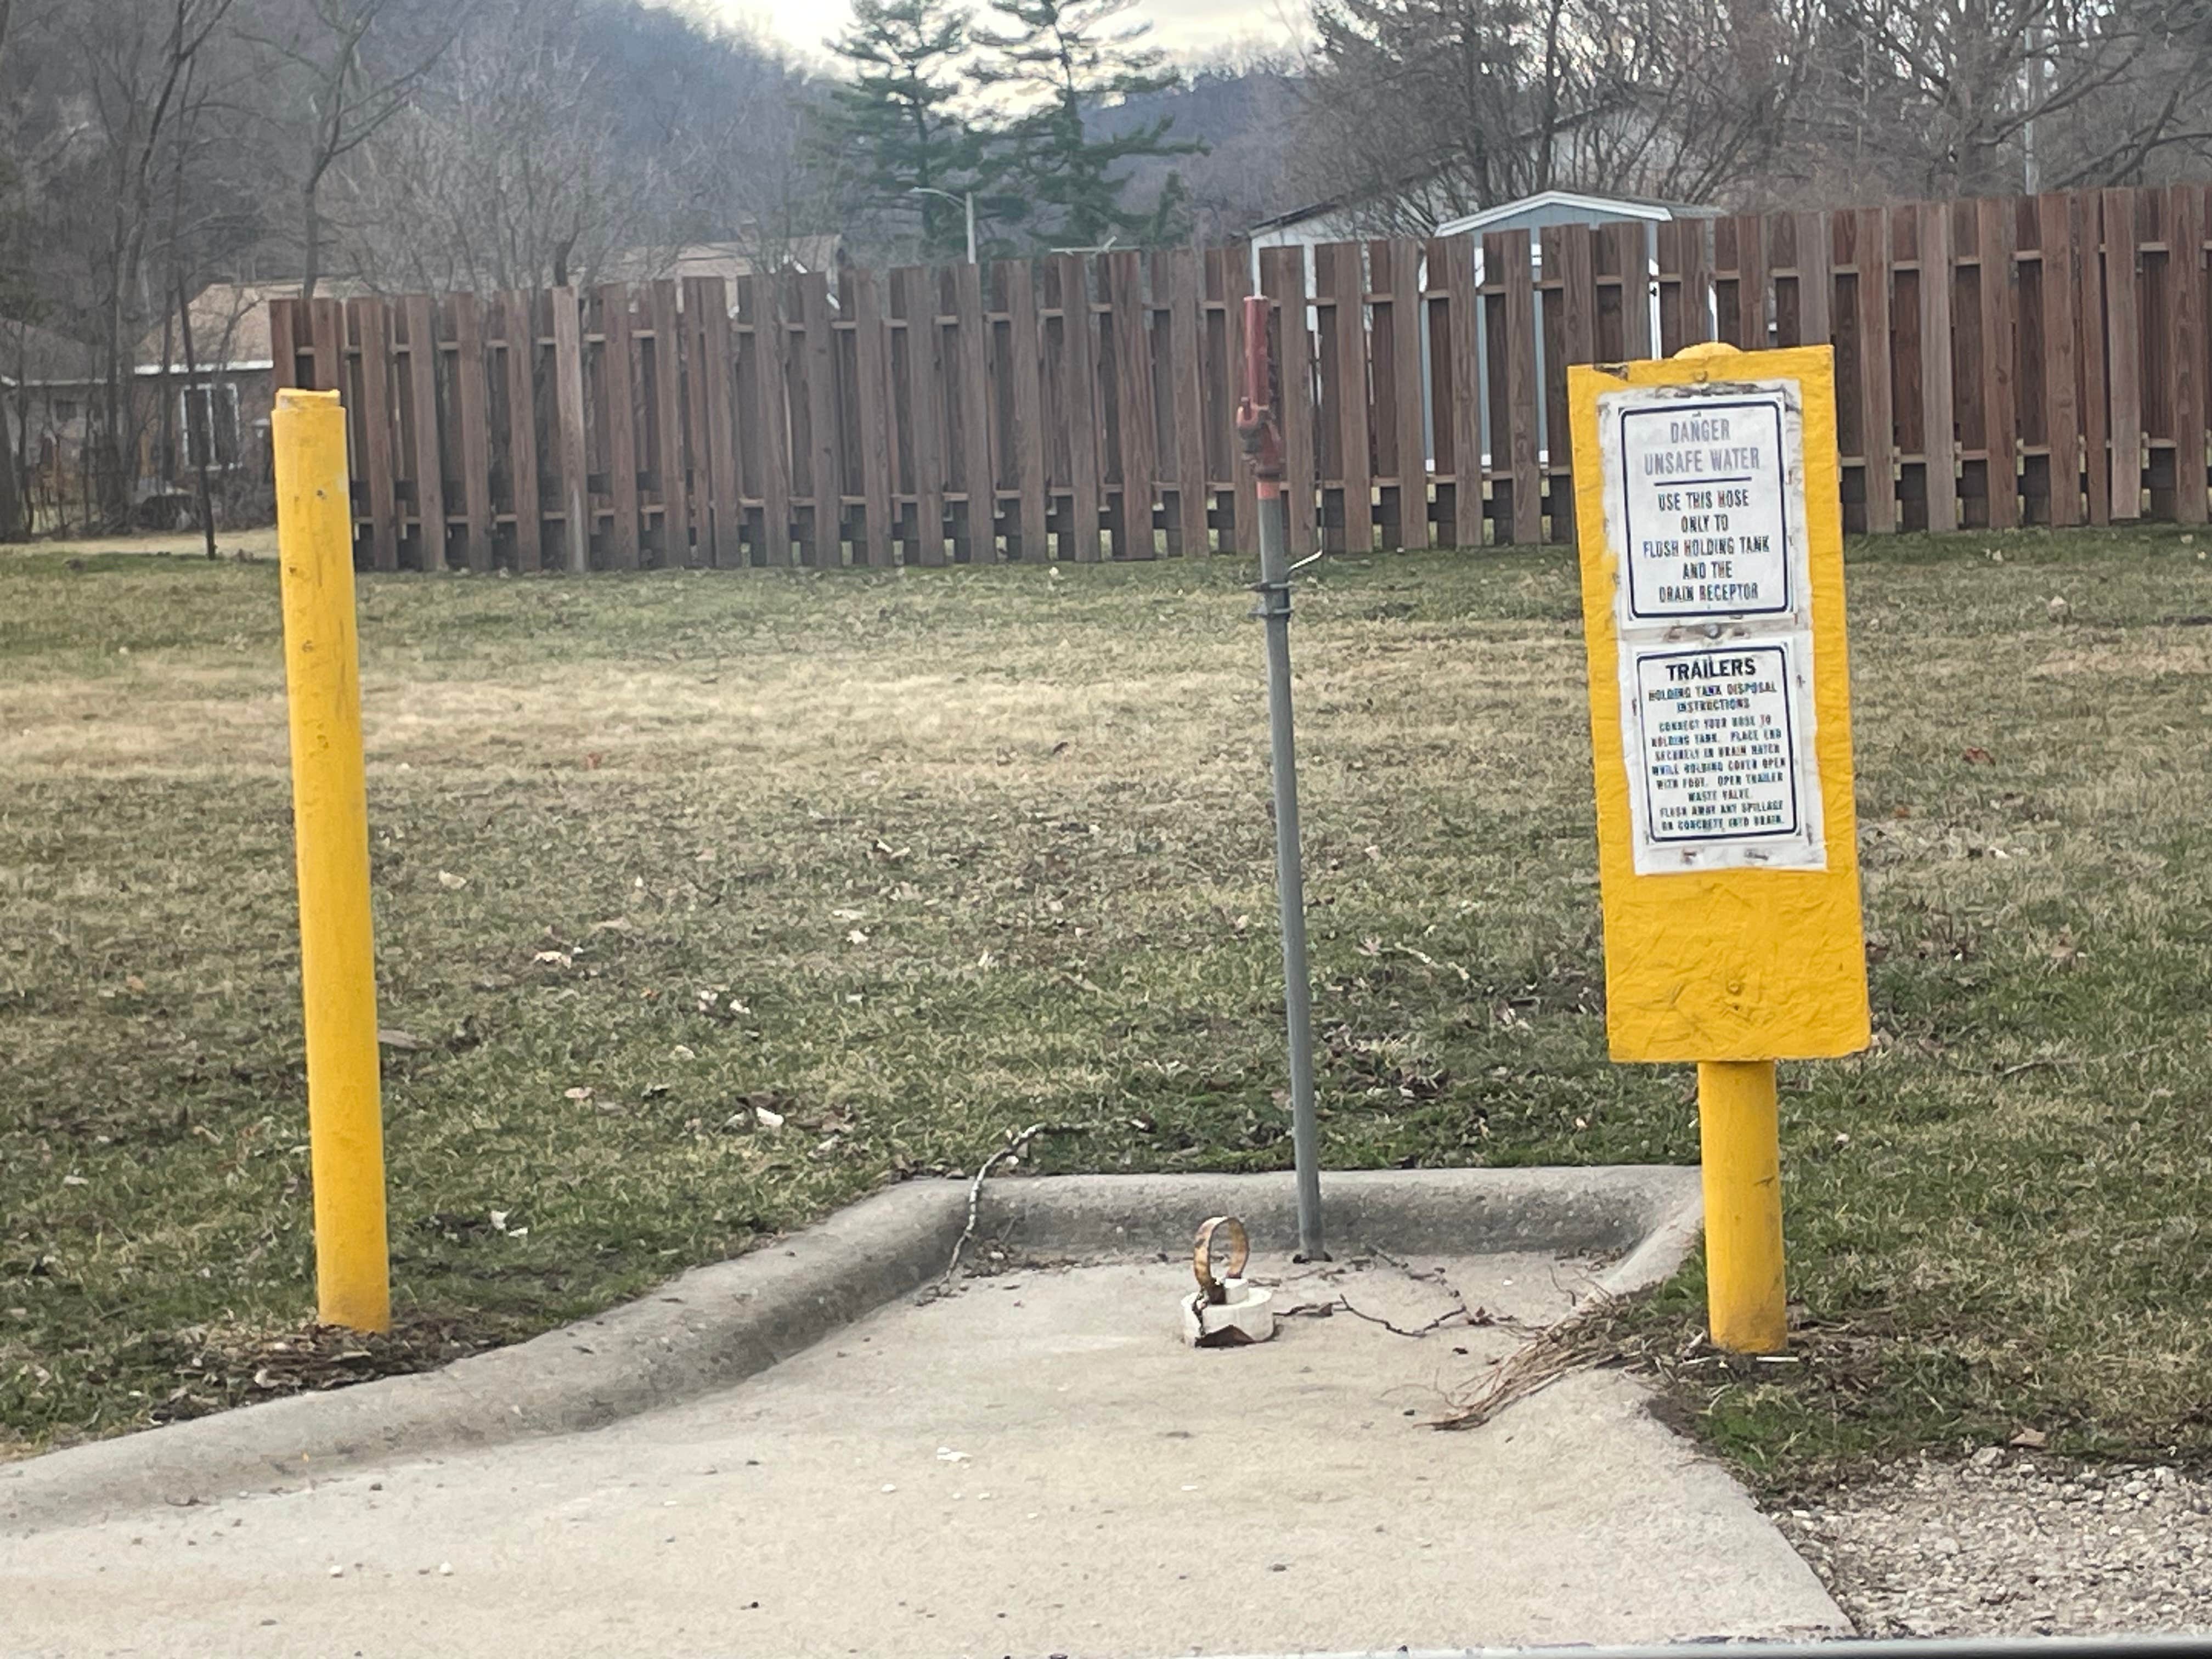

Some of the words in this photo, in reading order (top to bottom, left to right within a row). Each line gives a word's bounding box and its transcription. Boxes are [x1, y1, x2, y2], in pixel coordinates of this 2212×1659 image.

[1671, 419, 1730, 443] DANGER
[1645, 450, 1703, 476] UNSAFE
[1711, 447, 1759, 471] WATER
[1658, 493, 1681, 511] USE
[1686, 492, 1712, 509] THIS
[1718, 489, 1750, 507] HOSE
[1681, 515, 1709, 533] ONLY
[1714, 514, 1729, 531] TO
[1643, 540, 1679, 558] FLUSH
[1684, 538, 1734, 557] HOLDING
[1740, 535, 1770, 552] TANK
[1683, 562, 1706, 580] AND
[1711, 561, 1733, 578] THE
[1660, 585, 1694, 604] DRAIN
[1699, 583, 1758, 601] RECEPTOR
[1666, 658, 1756, 681] TRAILERS
[1649, 686, 1691, 701] HOLDING
[1695, 685, 1722, 697] TANK
[1727, 681, 1776, 695] DISPOSAL
[1677, 697, 1750, 713] INSTRUCTIONS
[1659, 719, 1699, 732] CONNECT
[1704, 718, 1726, 729] YOUR
[1760, 714, 1771, 726] TO
[1651, 735, 1689, 747] HOLDING
[1731, 730, 1758, 741] PLACE
[1764, 728, 1781, 739] END
[1684, 761, 1723, 773] HOLDING
[1763, 757, 1785, 768] OPEN
[1657, 779, 1678, 789] WITH
[1718, 775, 1741, 786] OPEN
[1746, 772, 1782, 783] TRAILER
[1688, 791, 1717, 802] WASTE
[1660, 806, 1686, 817] FLUSH
[1721, 803, 1736, 812] ANY
[1742, 800, 1783, 812] SPILLAGE
[1678, 819, 1723, 831] CONCRETE
